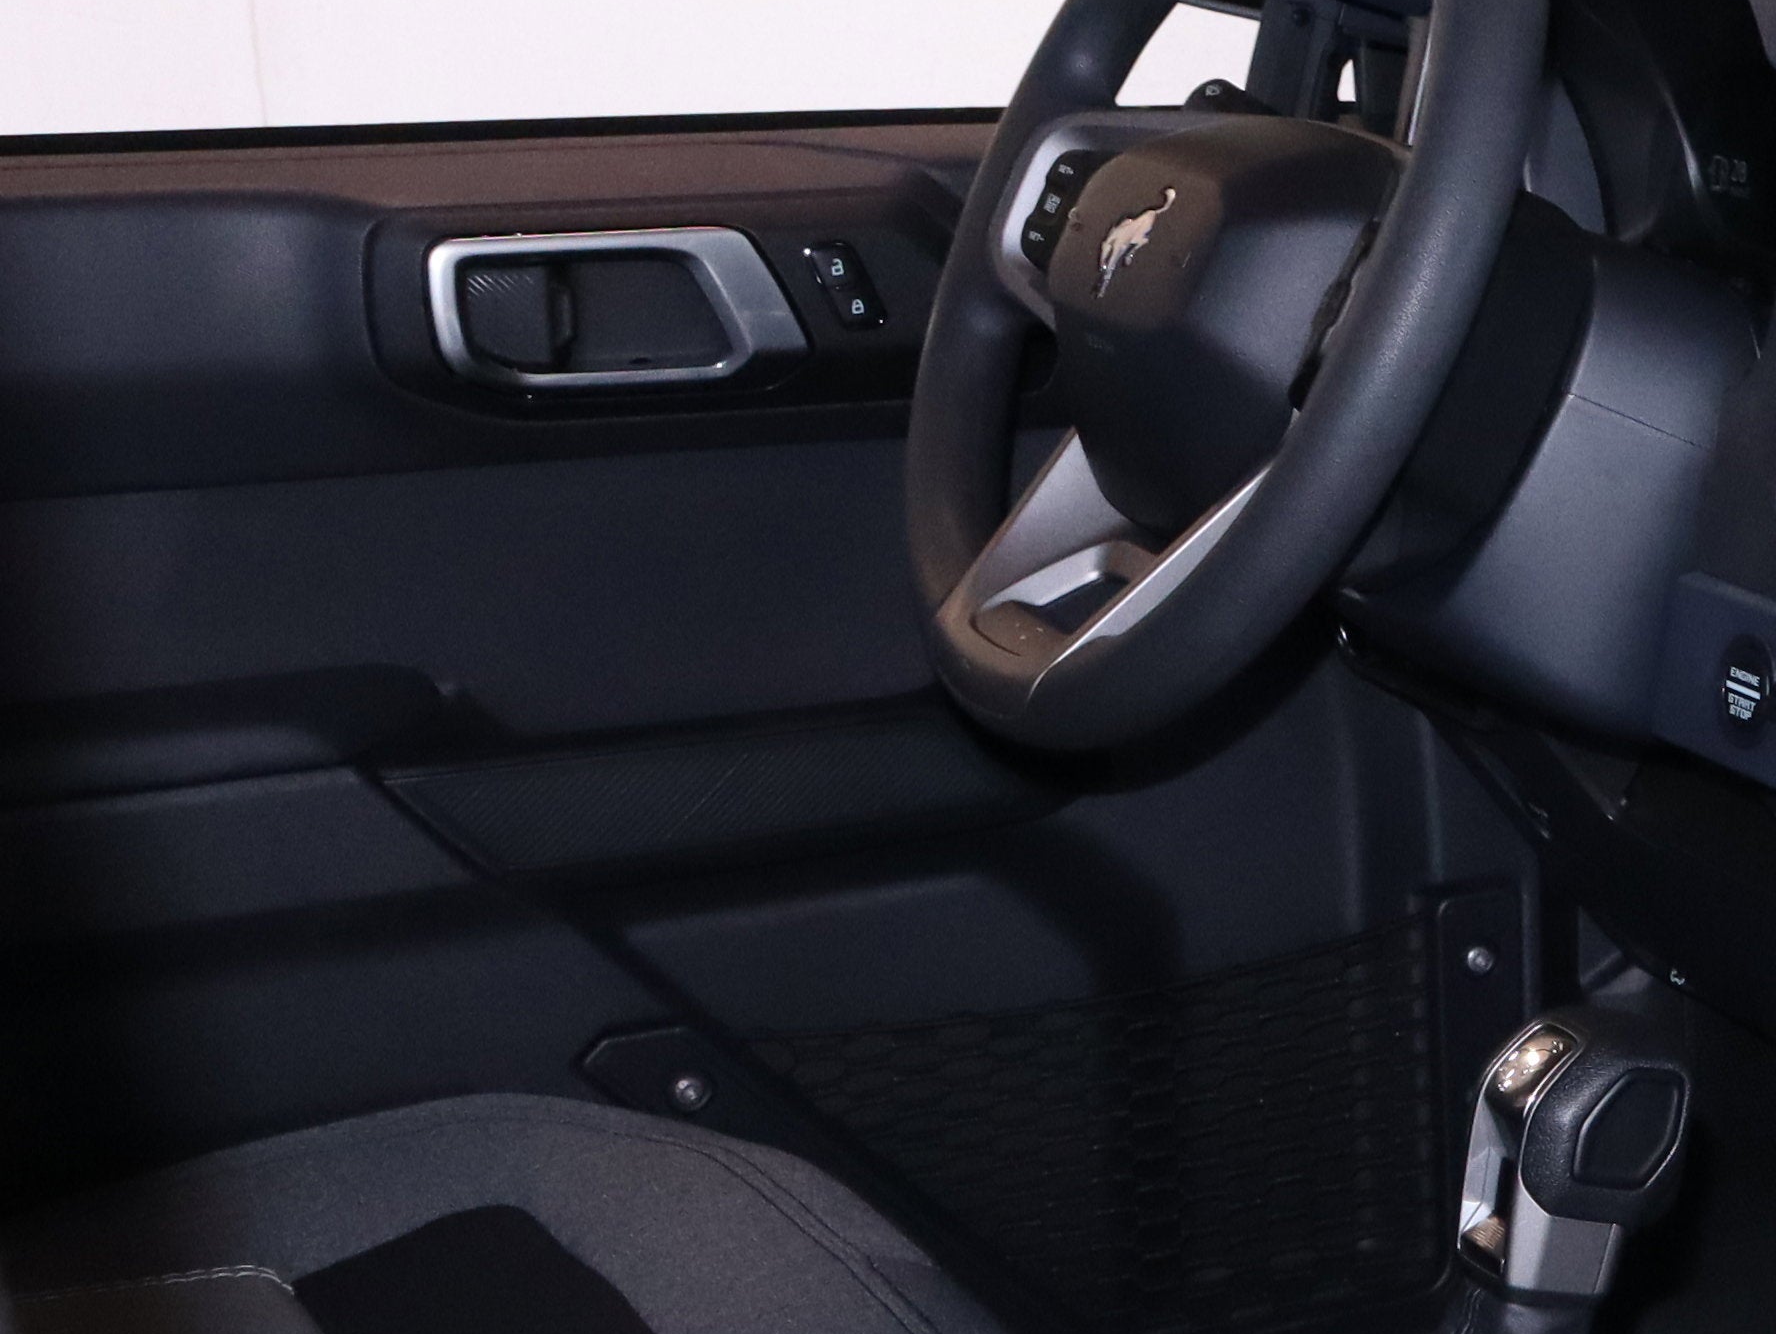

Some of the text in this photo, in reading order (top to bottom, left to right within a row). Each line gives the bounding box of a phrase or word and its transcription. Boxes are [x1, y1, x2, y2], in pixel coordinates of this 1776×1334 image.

[1730, 666, 1760, 687] ENGINE
[1728, 692, 1757, 711] START
[1729, 705, 1752, 720] STOP
